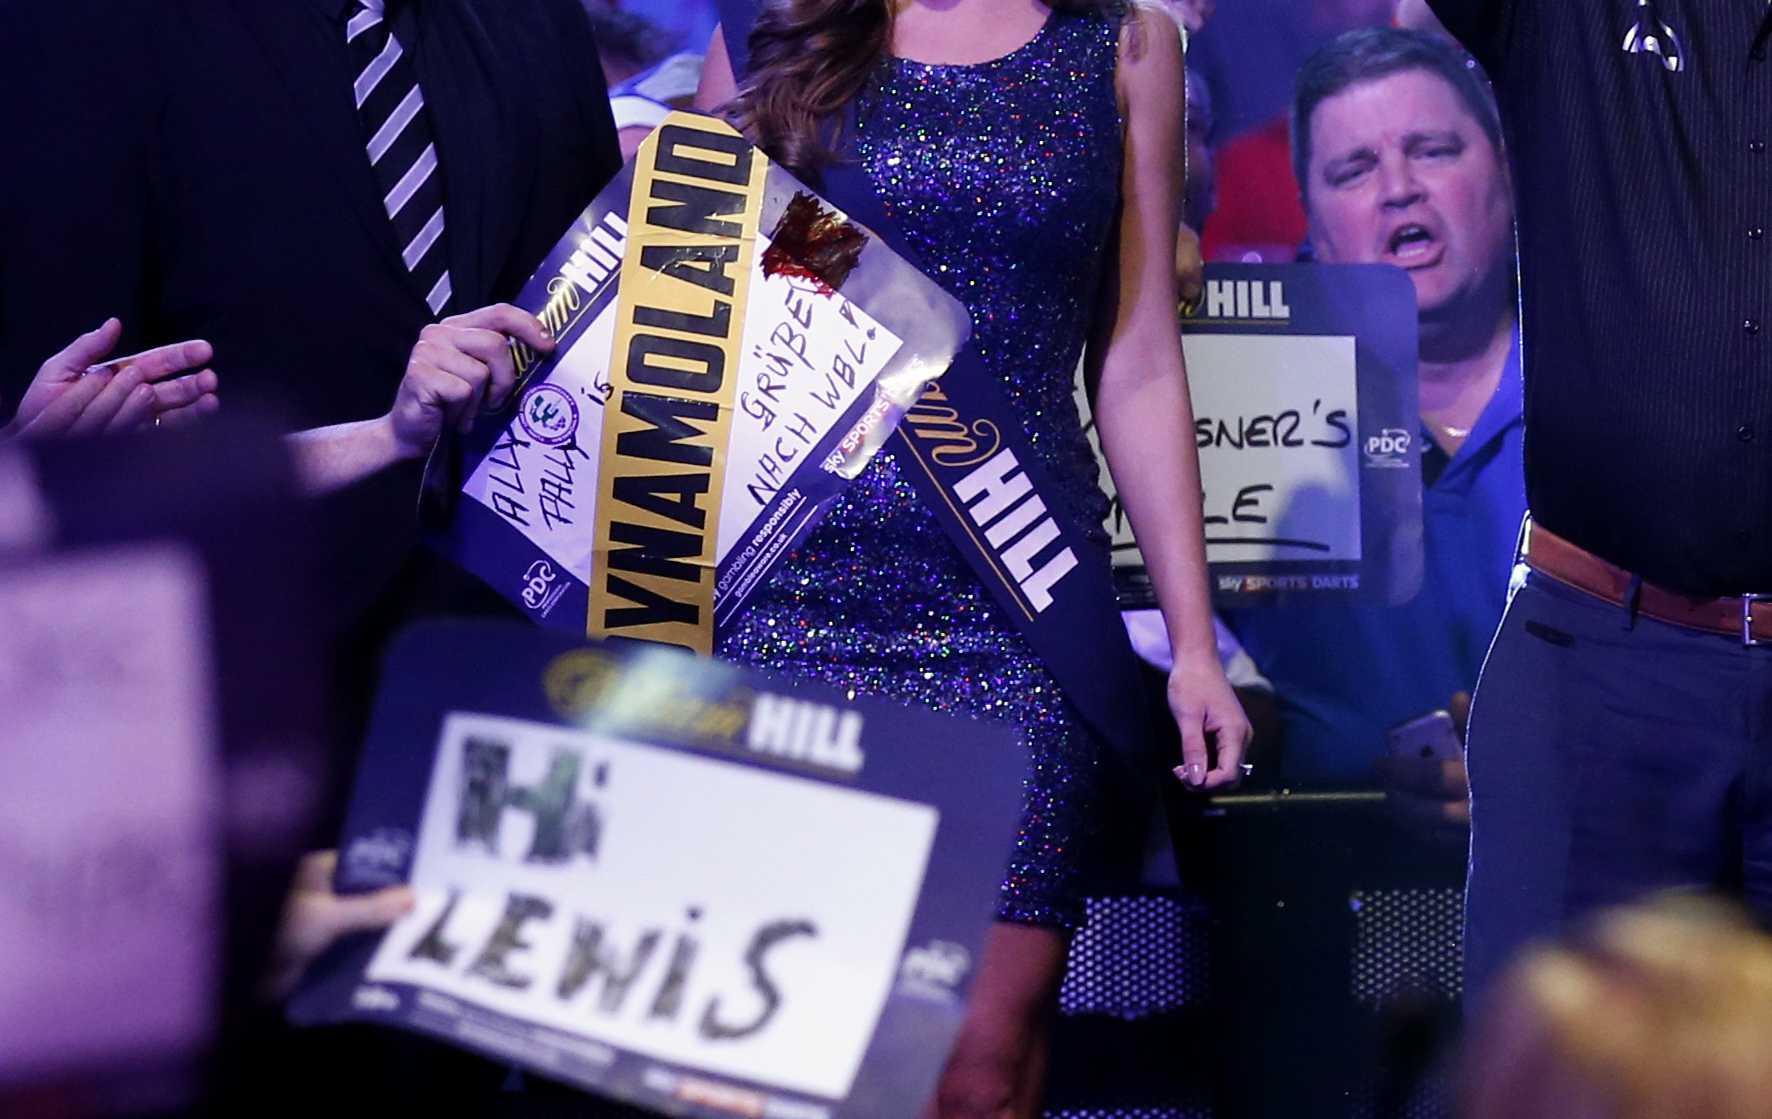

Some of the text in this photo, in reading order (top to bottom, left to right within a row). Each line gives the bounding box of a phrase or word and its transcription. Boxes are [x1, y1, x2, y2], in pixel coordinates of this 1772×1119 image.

[1206, 280, 1291, 319] HILL
[603, 124, 754, 658] YNAMOLAND
[1194, 397, 1352, 450] SNER'S
[746, 412, 818, 506] NACH
[841, 397, 892, 454] SPORTS
[1367, 434, 1410, 455] PDC
[718, 487, 802, 591] gambling responsibly
[952, 447, 1080, 613] HILL
[521, 562, 558, 605] PDC
[747, 692, 866, 771] HILL
